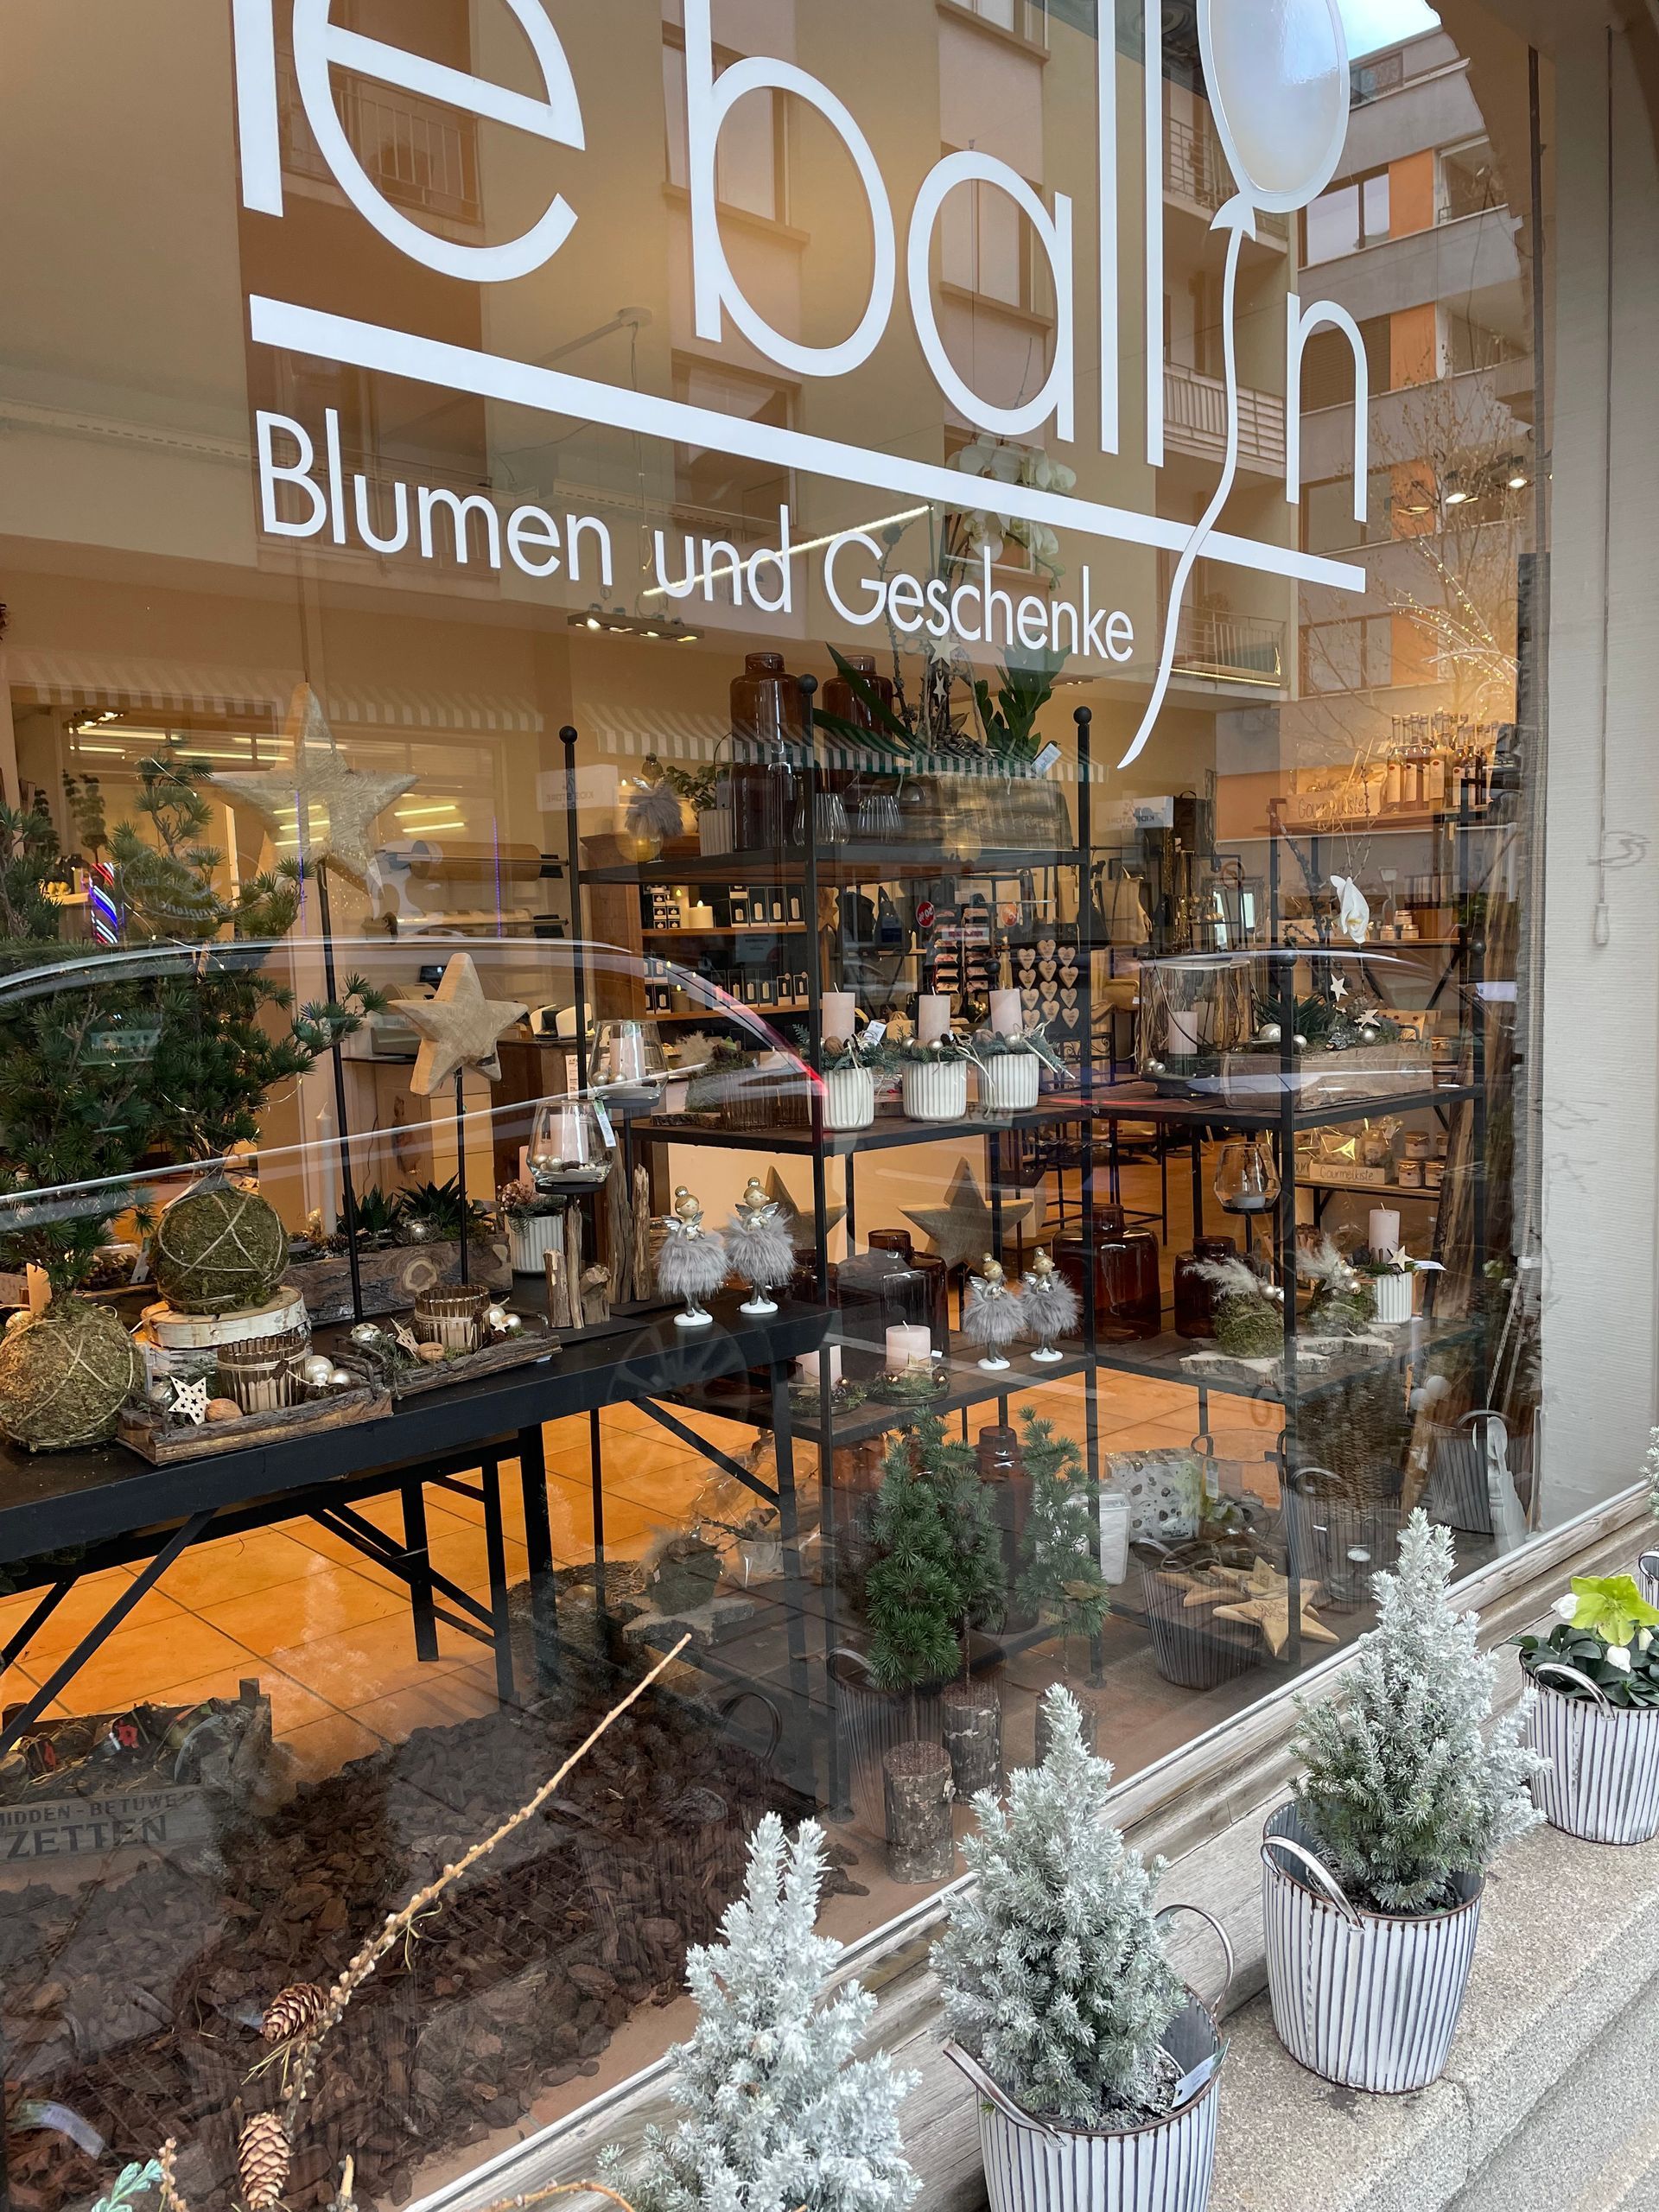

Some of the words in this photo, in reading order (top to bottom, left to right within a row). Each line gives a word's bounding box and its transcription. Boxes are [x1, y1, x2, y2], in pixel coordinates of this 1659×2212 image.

[256, 408, 613, 586] Blumen
[653, 504, 792, 613] und
[823, 531, 1135, 662] Geschenke
[4, 1815, 167, 1859] ZETTEN
